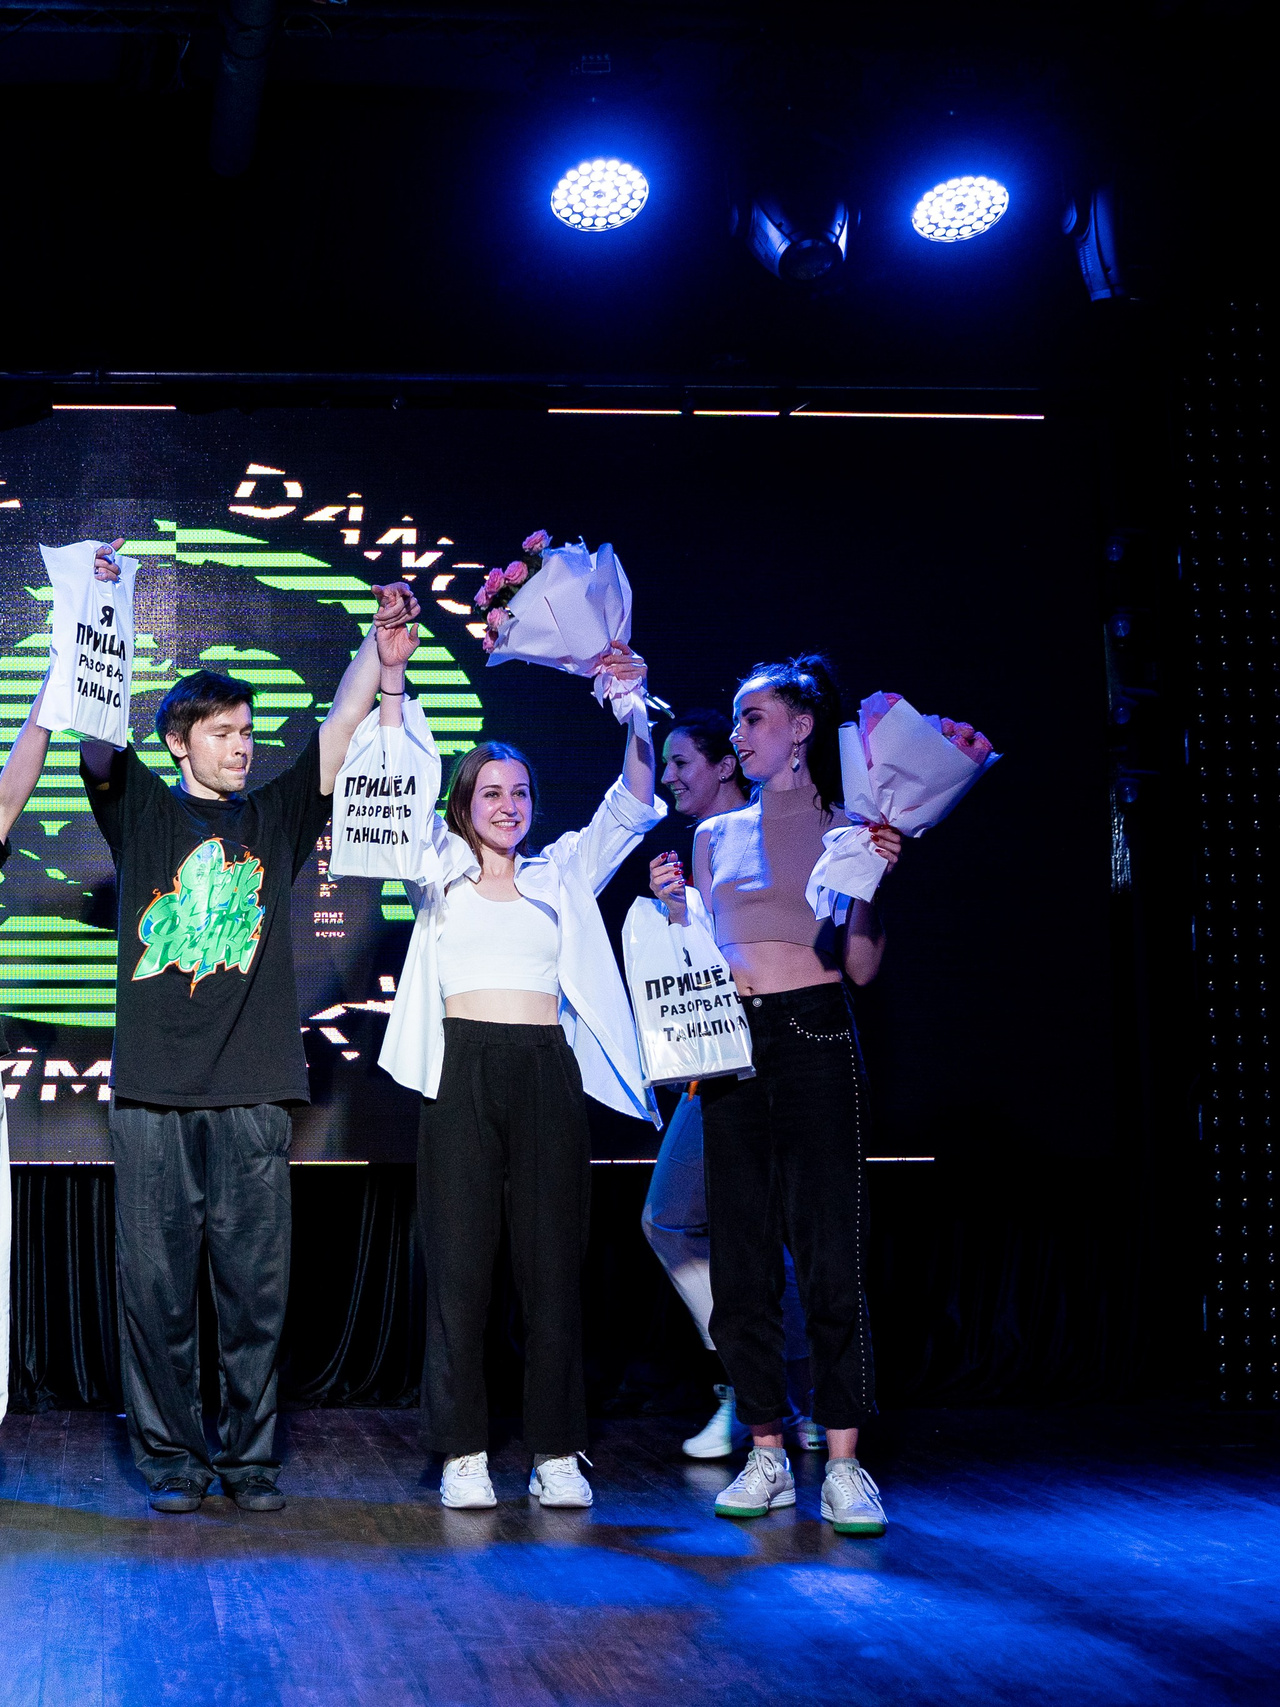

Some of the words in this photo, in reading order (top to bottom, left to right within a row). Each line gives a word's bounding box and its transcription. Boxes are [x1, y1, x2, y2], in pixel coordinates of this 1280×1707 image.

[100, 605, 115, 628] Я
[344, 774, 416, 799] ПРИШЁЛ
[346, 826, 410, 846] ТАНЦПОЛ
[660, 990, 743, 1018] РАЗОРВАТЬ
